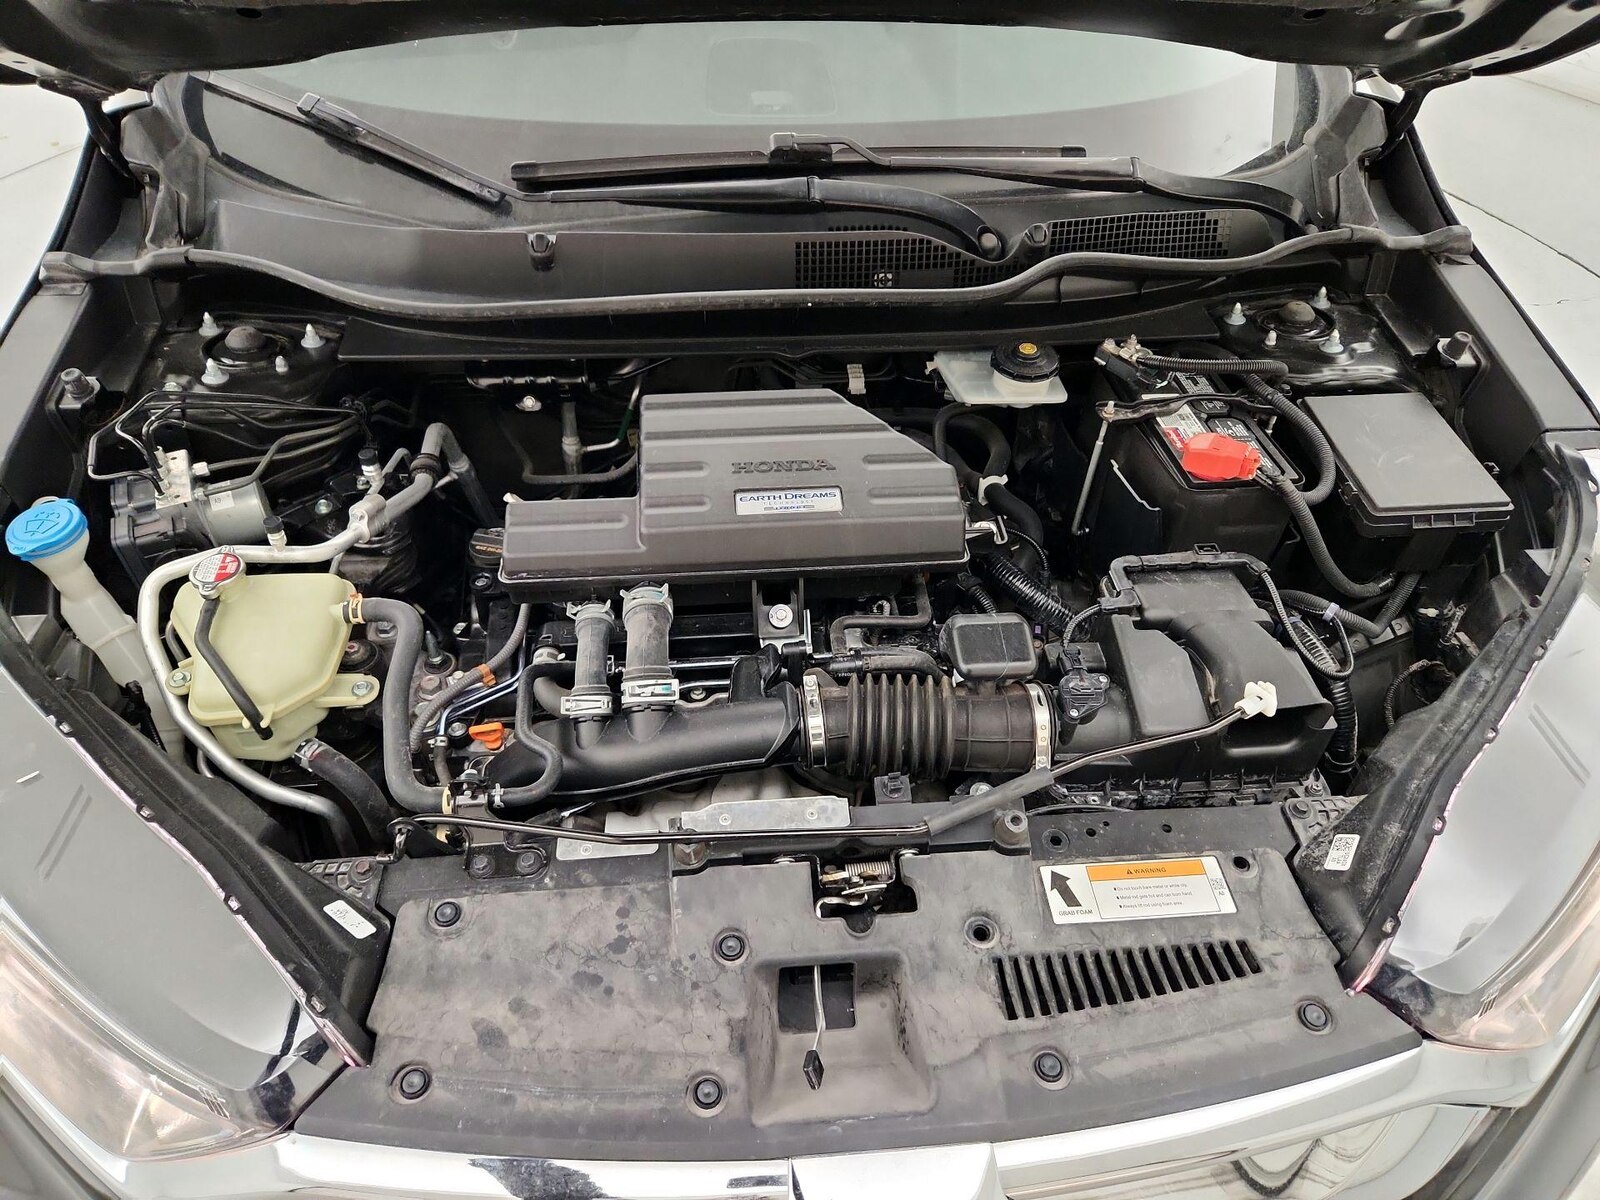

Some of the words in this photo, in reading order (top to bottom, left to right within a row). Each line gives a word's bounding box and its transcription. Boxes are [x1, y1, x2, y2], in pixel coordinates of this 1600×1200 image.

[731, 459, 837, 474] HONDA
[739, 493, 782, 502] EARTH
[785, 491, 837, 500] DREAMS
[1133, 866, 1167, 874] WARNING
